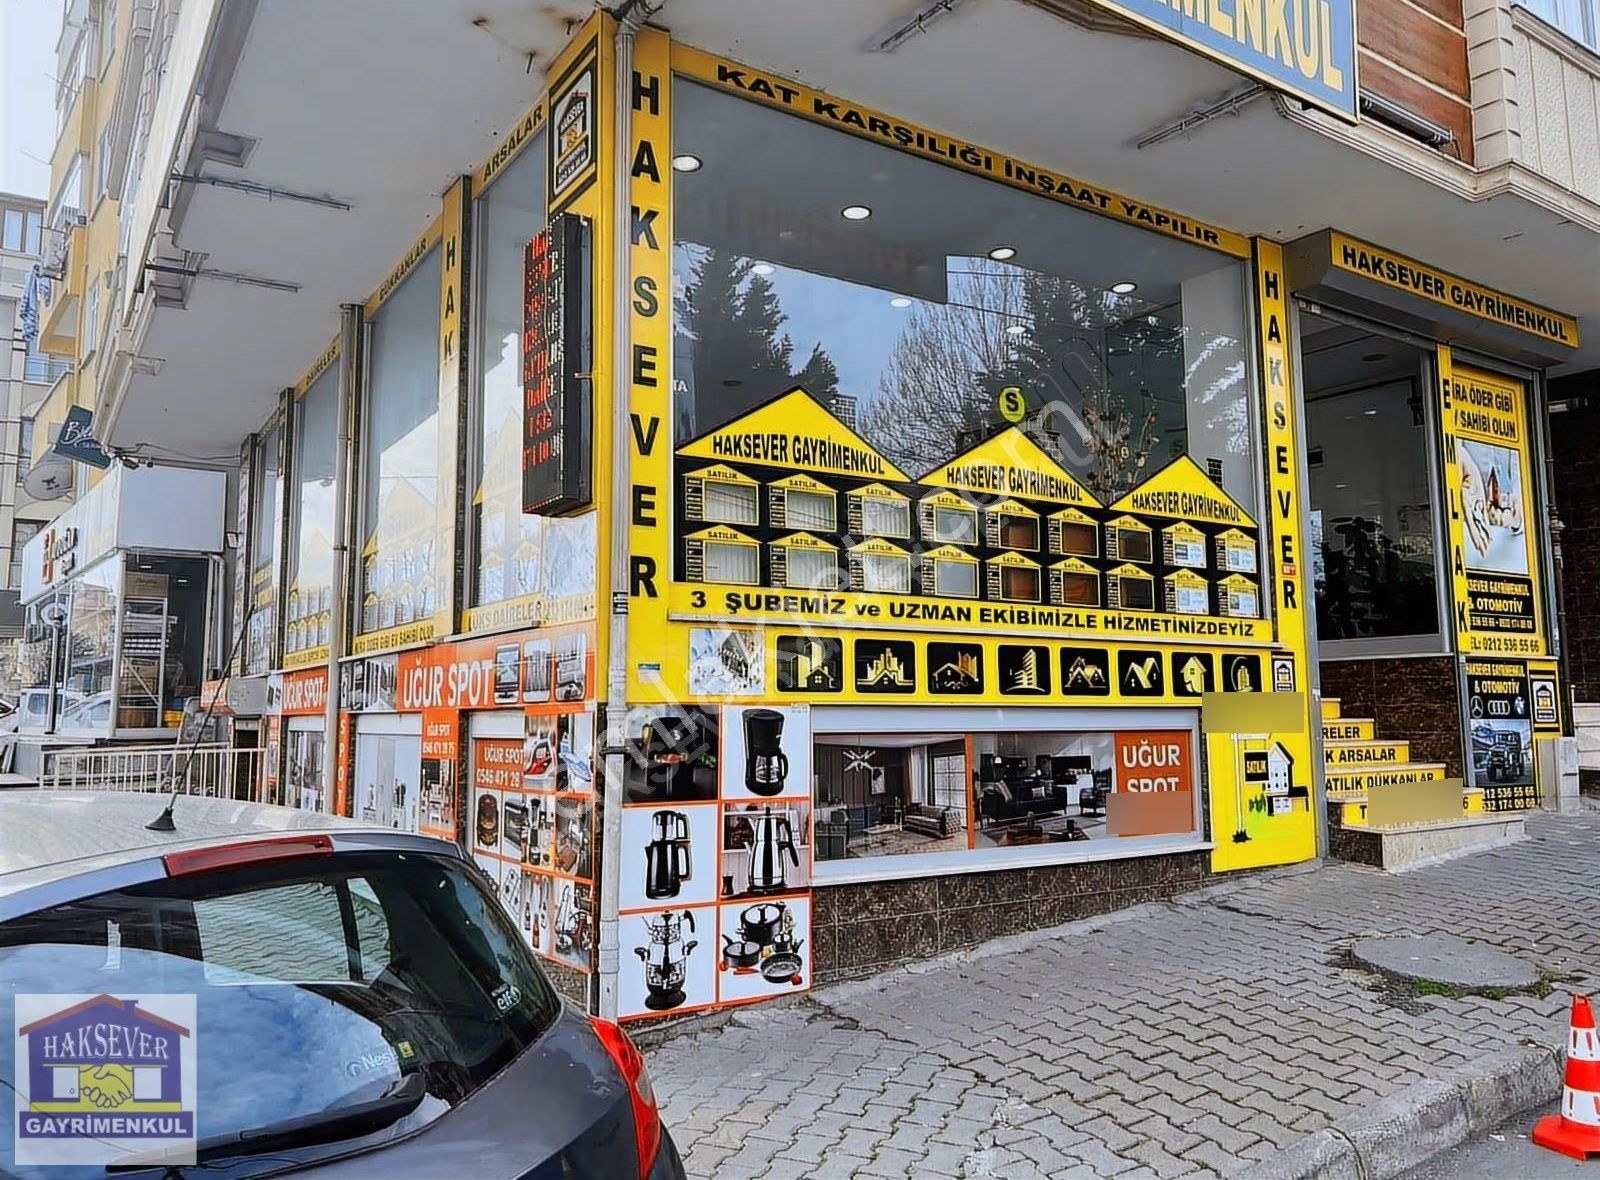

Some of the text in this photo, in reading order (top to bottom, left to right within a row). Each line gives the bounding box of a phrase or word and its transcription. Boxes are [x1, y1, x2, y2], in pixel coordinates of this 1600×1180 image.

[482, 104, 544, 183] ARSALAR
[717, 64, 1221, 246] KAT KARŞILIĞI İNŞAAT YAPILIR
[1342, 244, 1569, 341] HAKSEVER GAYRİMENKUL
[630, 70, 661, 598] HAKSEVER
[1469, 382, 1494, 409] ÖDER
[1495, 391, 1514, 413] GİBİ
[1265, 269, 1298, 609] HAKSEVER
[1460, 409, 1516, 439] SAHİBİ OLUN
[712, 433, 885, 475] HAKSEVER GAYRİMENKUL
[708, 470, 737, 480] SATILIK
[789, 480, 817, 489] SATILIK
[946, 466, 1083, 502] HAKSEVER GAYRİMENKUL
[1132, 490, 1241, 523] HAKSEVER GAYRİMENKUL
[1442, 378, 1470, 634] EMLAK
[708, 531, 738, 540] SATILIK
[790, 538, 818, 546] SATILIK
[690, 590, 1254, 638] 3 ŞUBEMİZ ve UZMAN EKİBİMİZLE HİZMETİNİZDEYİZ
[1476, 598, 1523, 613] OTOMOTİV
[283, 673, 325, 710] UĞUR SPOT
[402, 658, 494, 708] UĞUR SPOT
[1482, 679, 1520, 694] OTOMOTİV
[1322, 726, 1360, 740] RELER
[484, 744, 524, 765] UĞUR SPOT
[1122, 738, 1181, 768] UĞUR
[1339, 748, 1396, 762] ARSALAR
[1325, 776, 1363, 792] ATILIK
